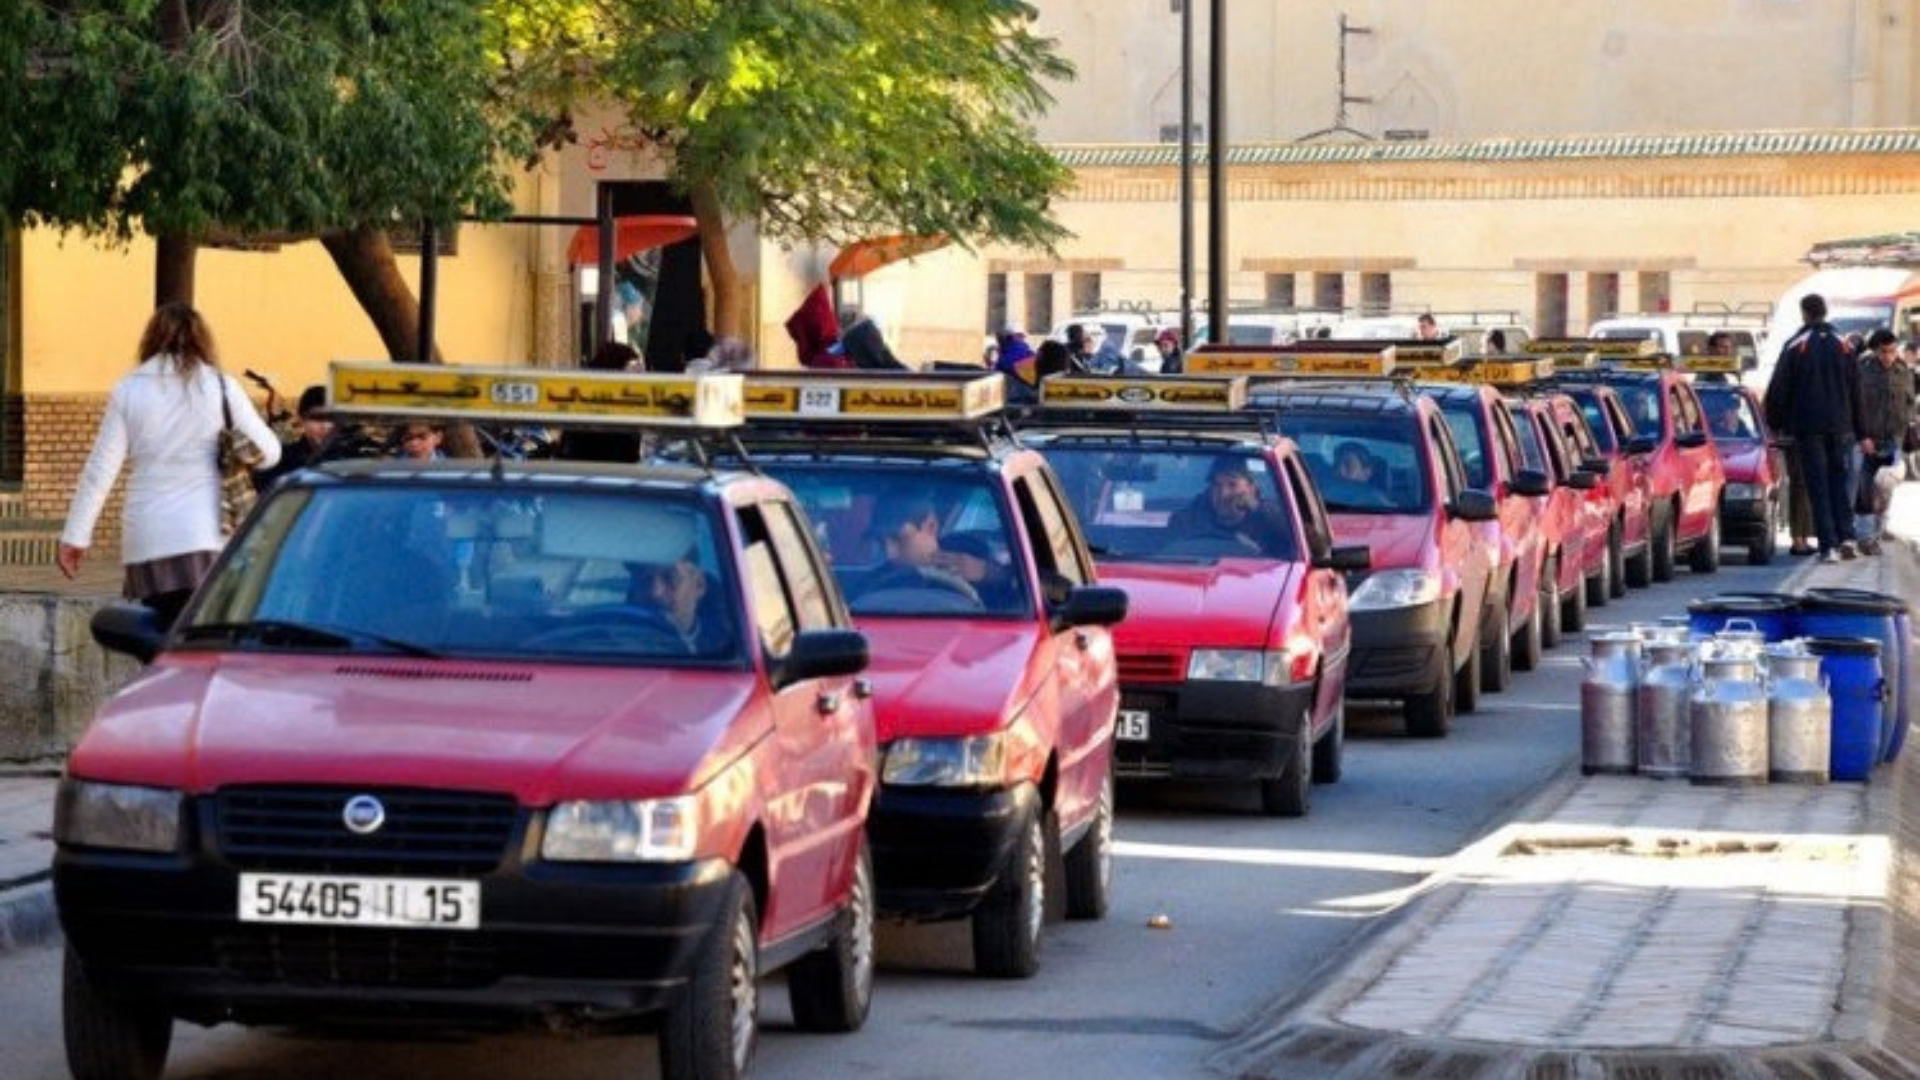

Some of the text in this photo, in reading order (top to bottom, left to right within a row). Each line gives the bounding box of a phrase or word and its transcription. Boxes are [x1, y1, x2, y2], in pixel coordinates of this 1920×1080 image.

[495, 382, 535, 402] 551
[1117, 712, 1143, 736] 15
[256, 880, 361, 918] 54405
[424, 885, 462, 923] 15
